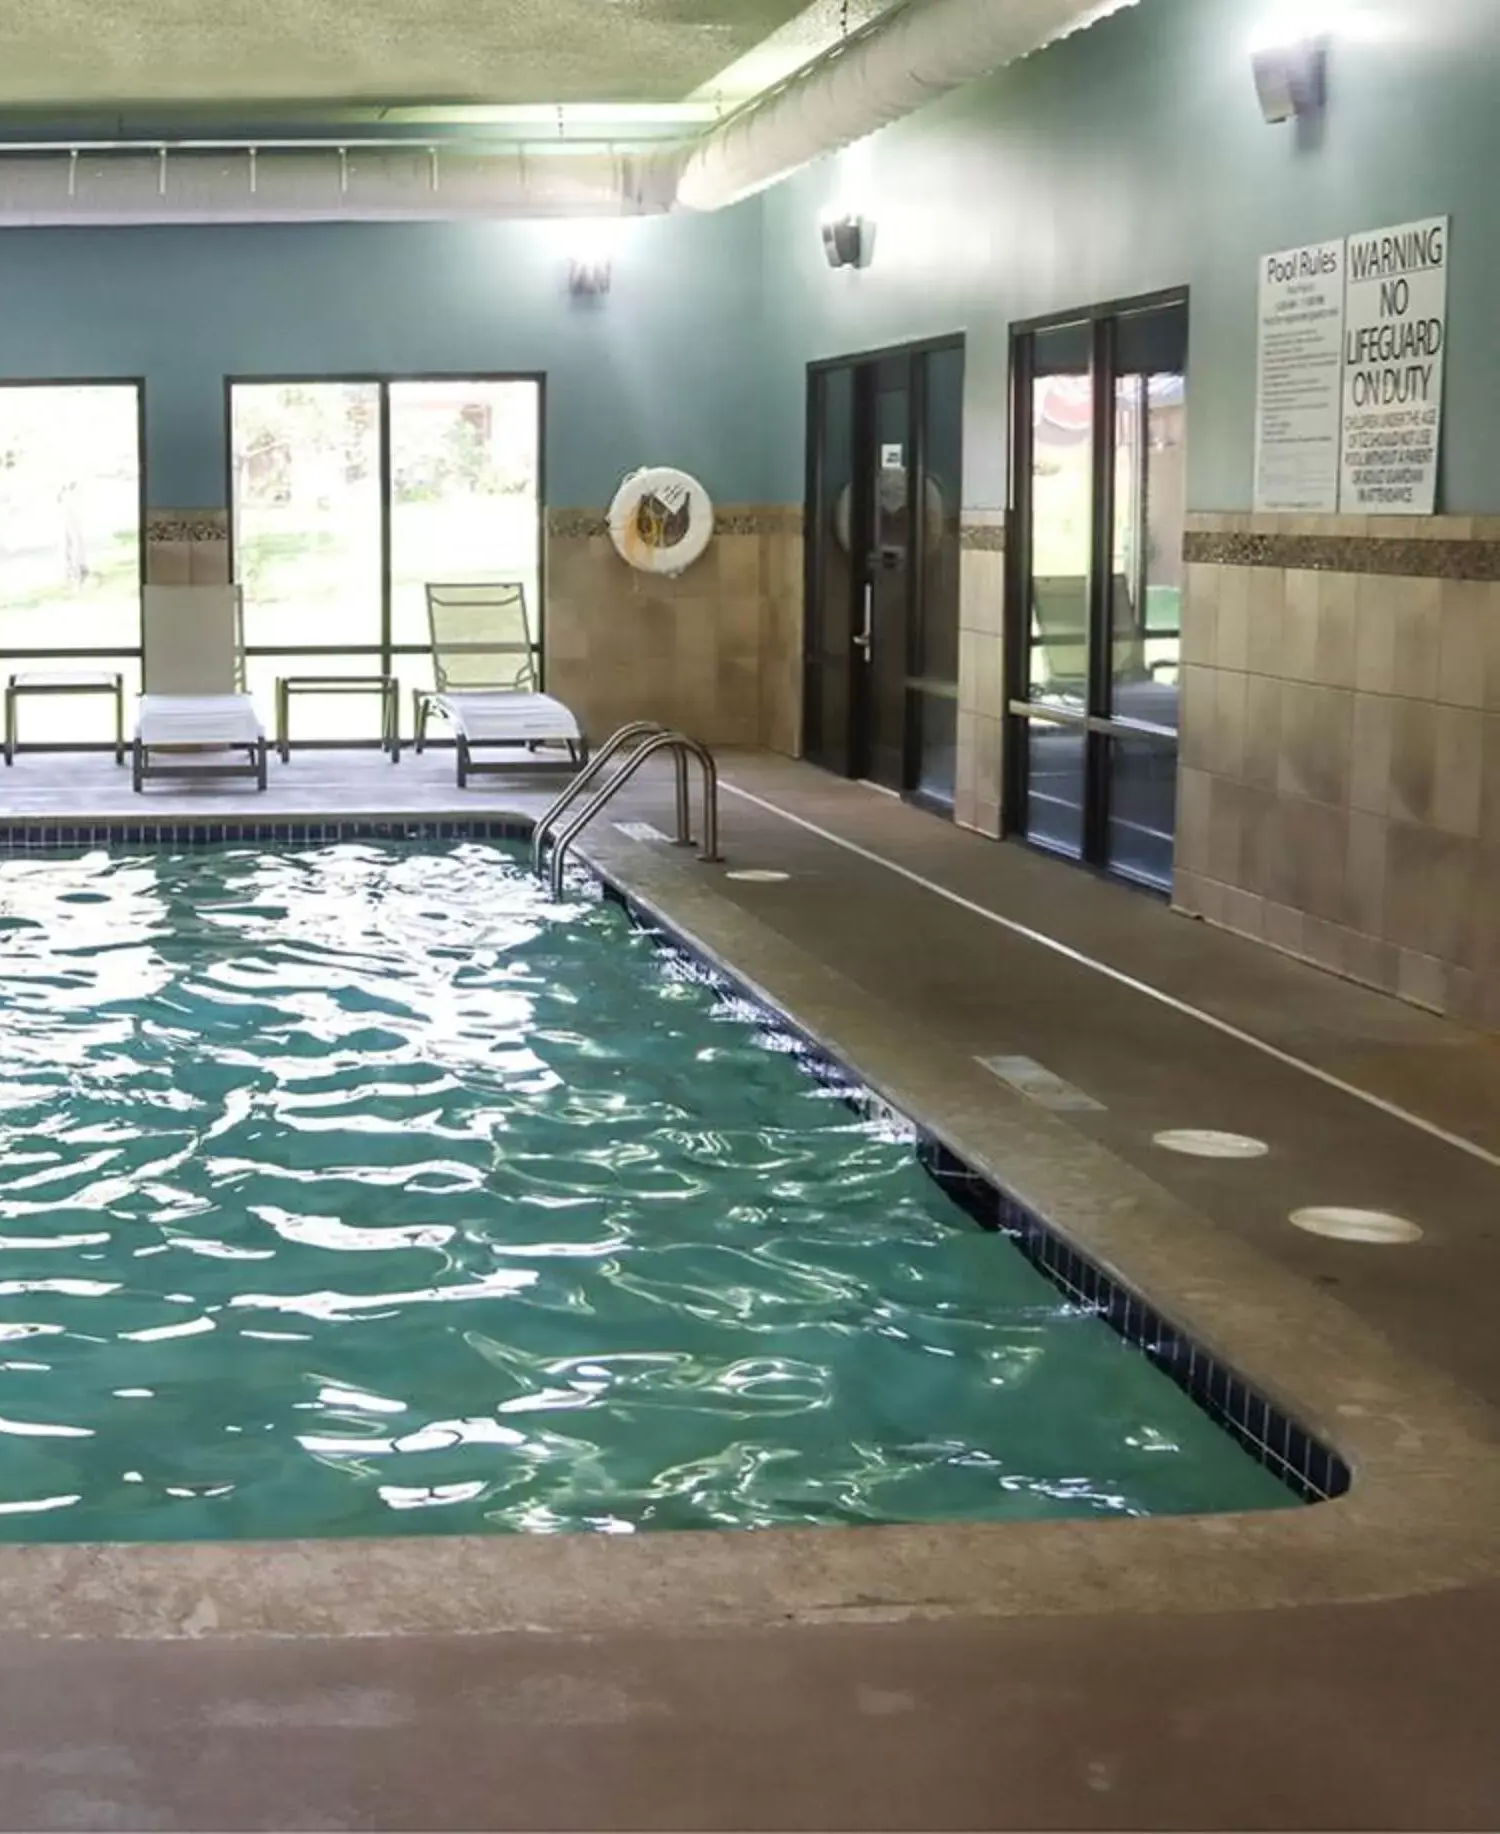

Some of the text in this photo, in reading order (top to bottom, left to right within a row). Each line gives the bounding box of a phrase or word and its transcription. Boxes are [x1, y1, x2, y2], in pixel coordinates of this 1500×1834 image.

[1267, 248, 1337, 284] Pool Rules
[1351, 227, 1443, 278] WARNING
[1380, 279, 1409, 317] NO
[1347, 318, 1442, 365] LIFEGUARD
[1353, 364, 1432, 406] ON DUTY
